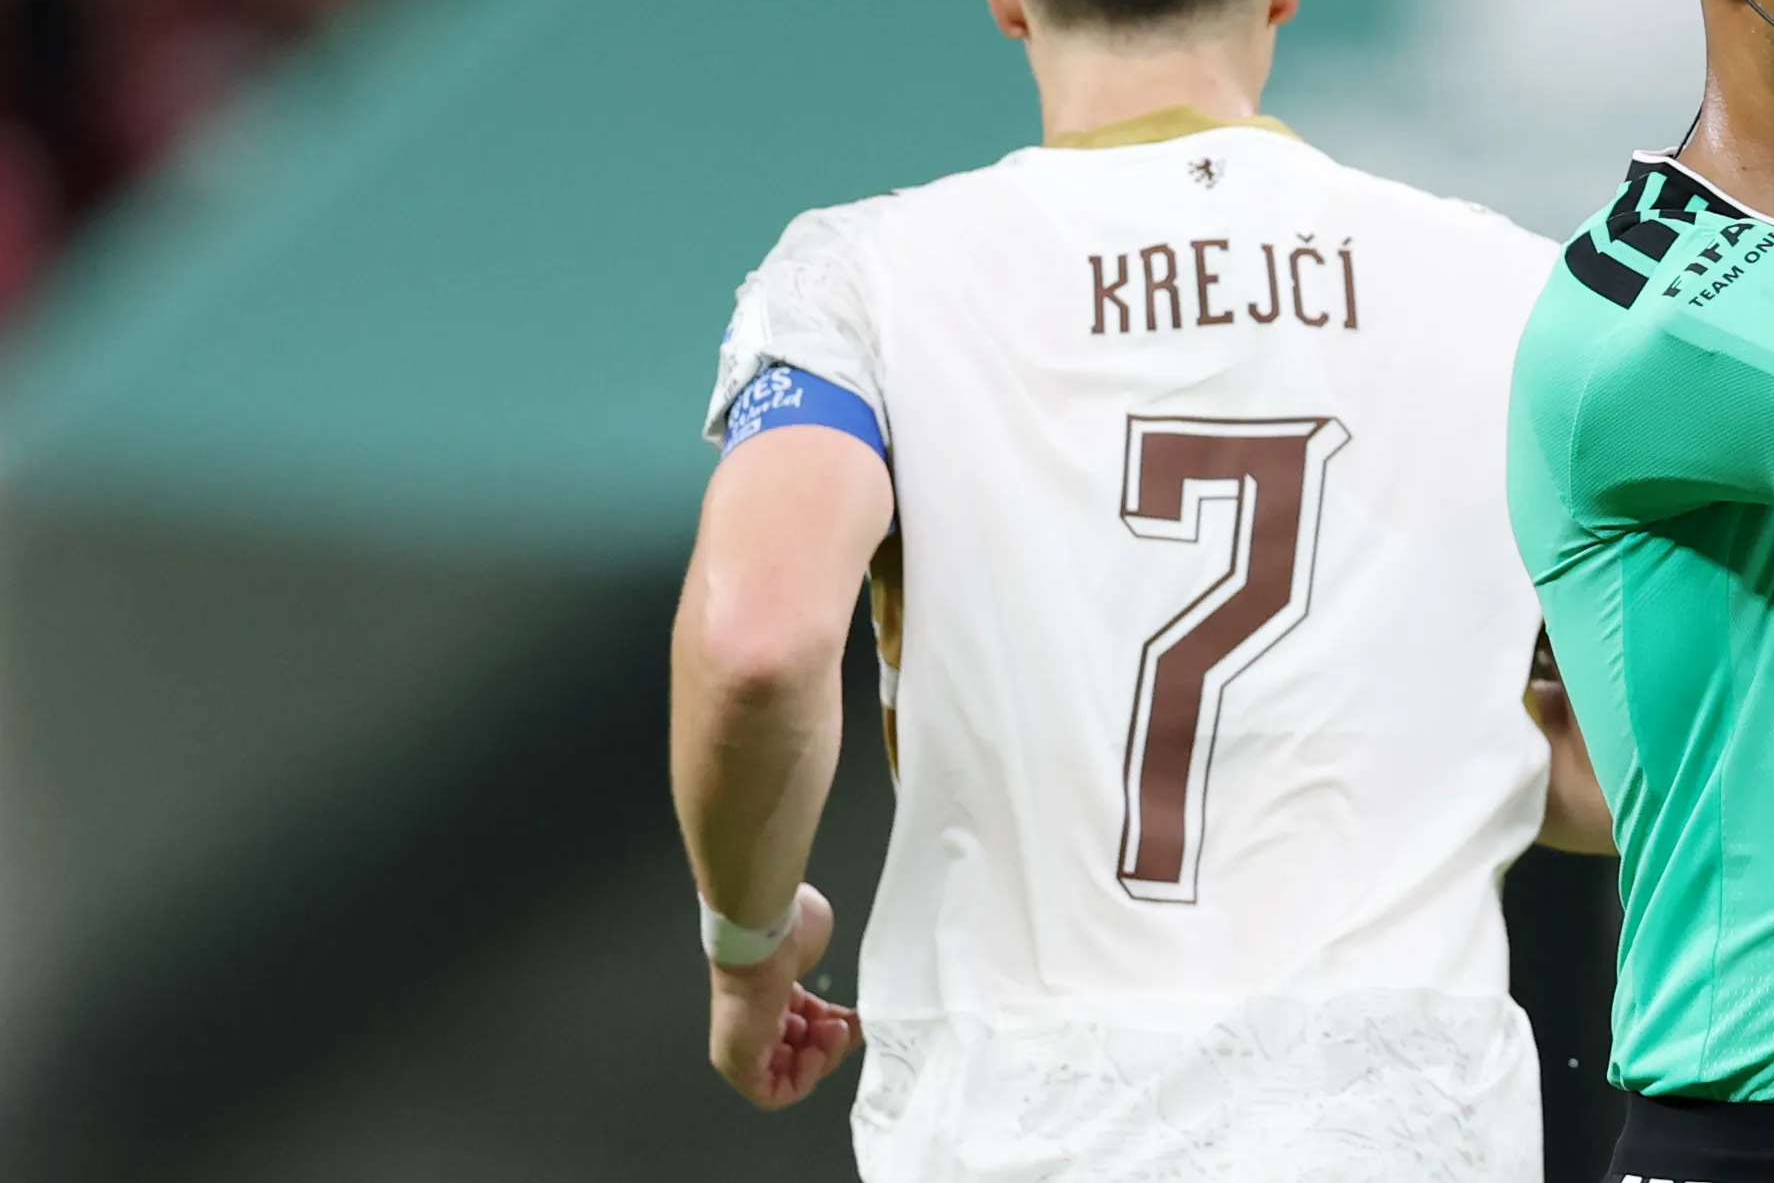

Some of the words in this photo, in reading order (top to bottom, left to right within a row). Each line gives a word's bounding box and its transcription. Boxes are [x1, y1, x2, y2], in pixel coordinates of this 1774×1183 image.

[1088, 234, 1359, 335] KREJČÍ
[1662, 223, 1756, 297] FIFA
[1688, 266, 1744, 307] TEAM
[1117, 413, 1352, 905] 7
